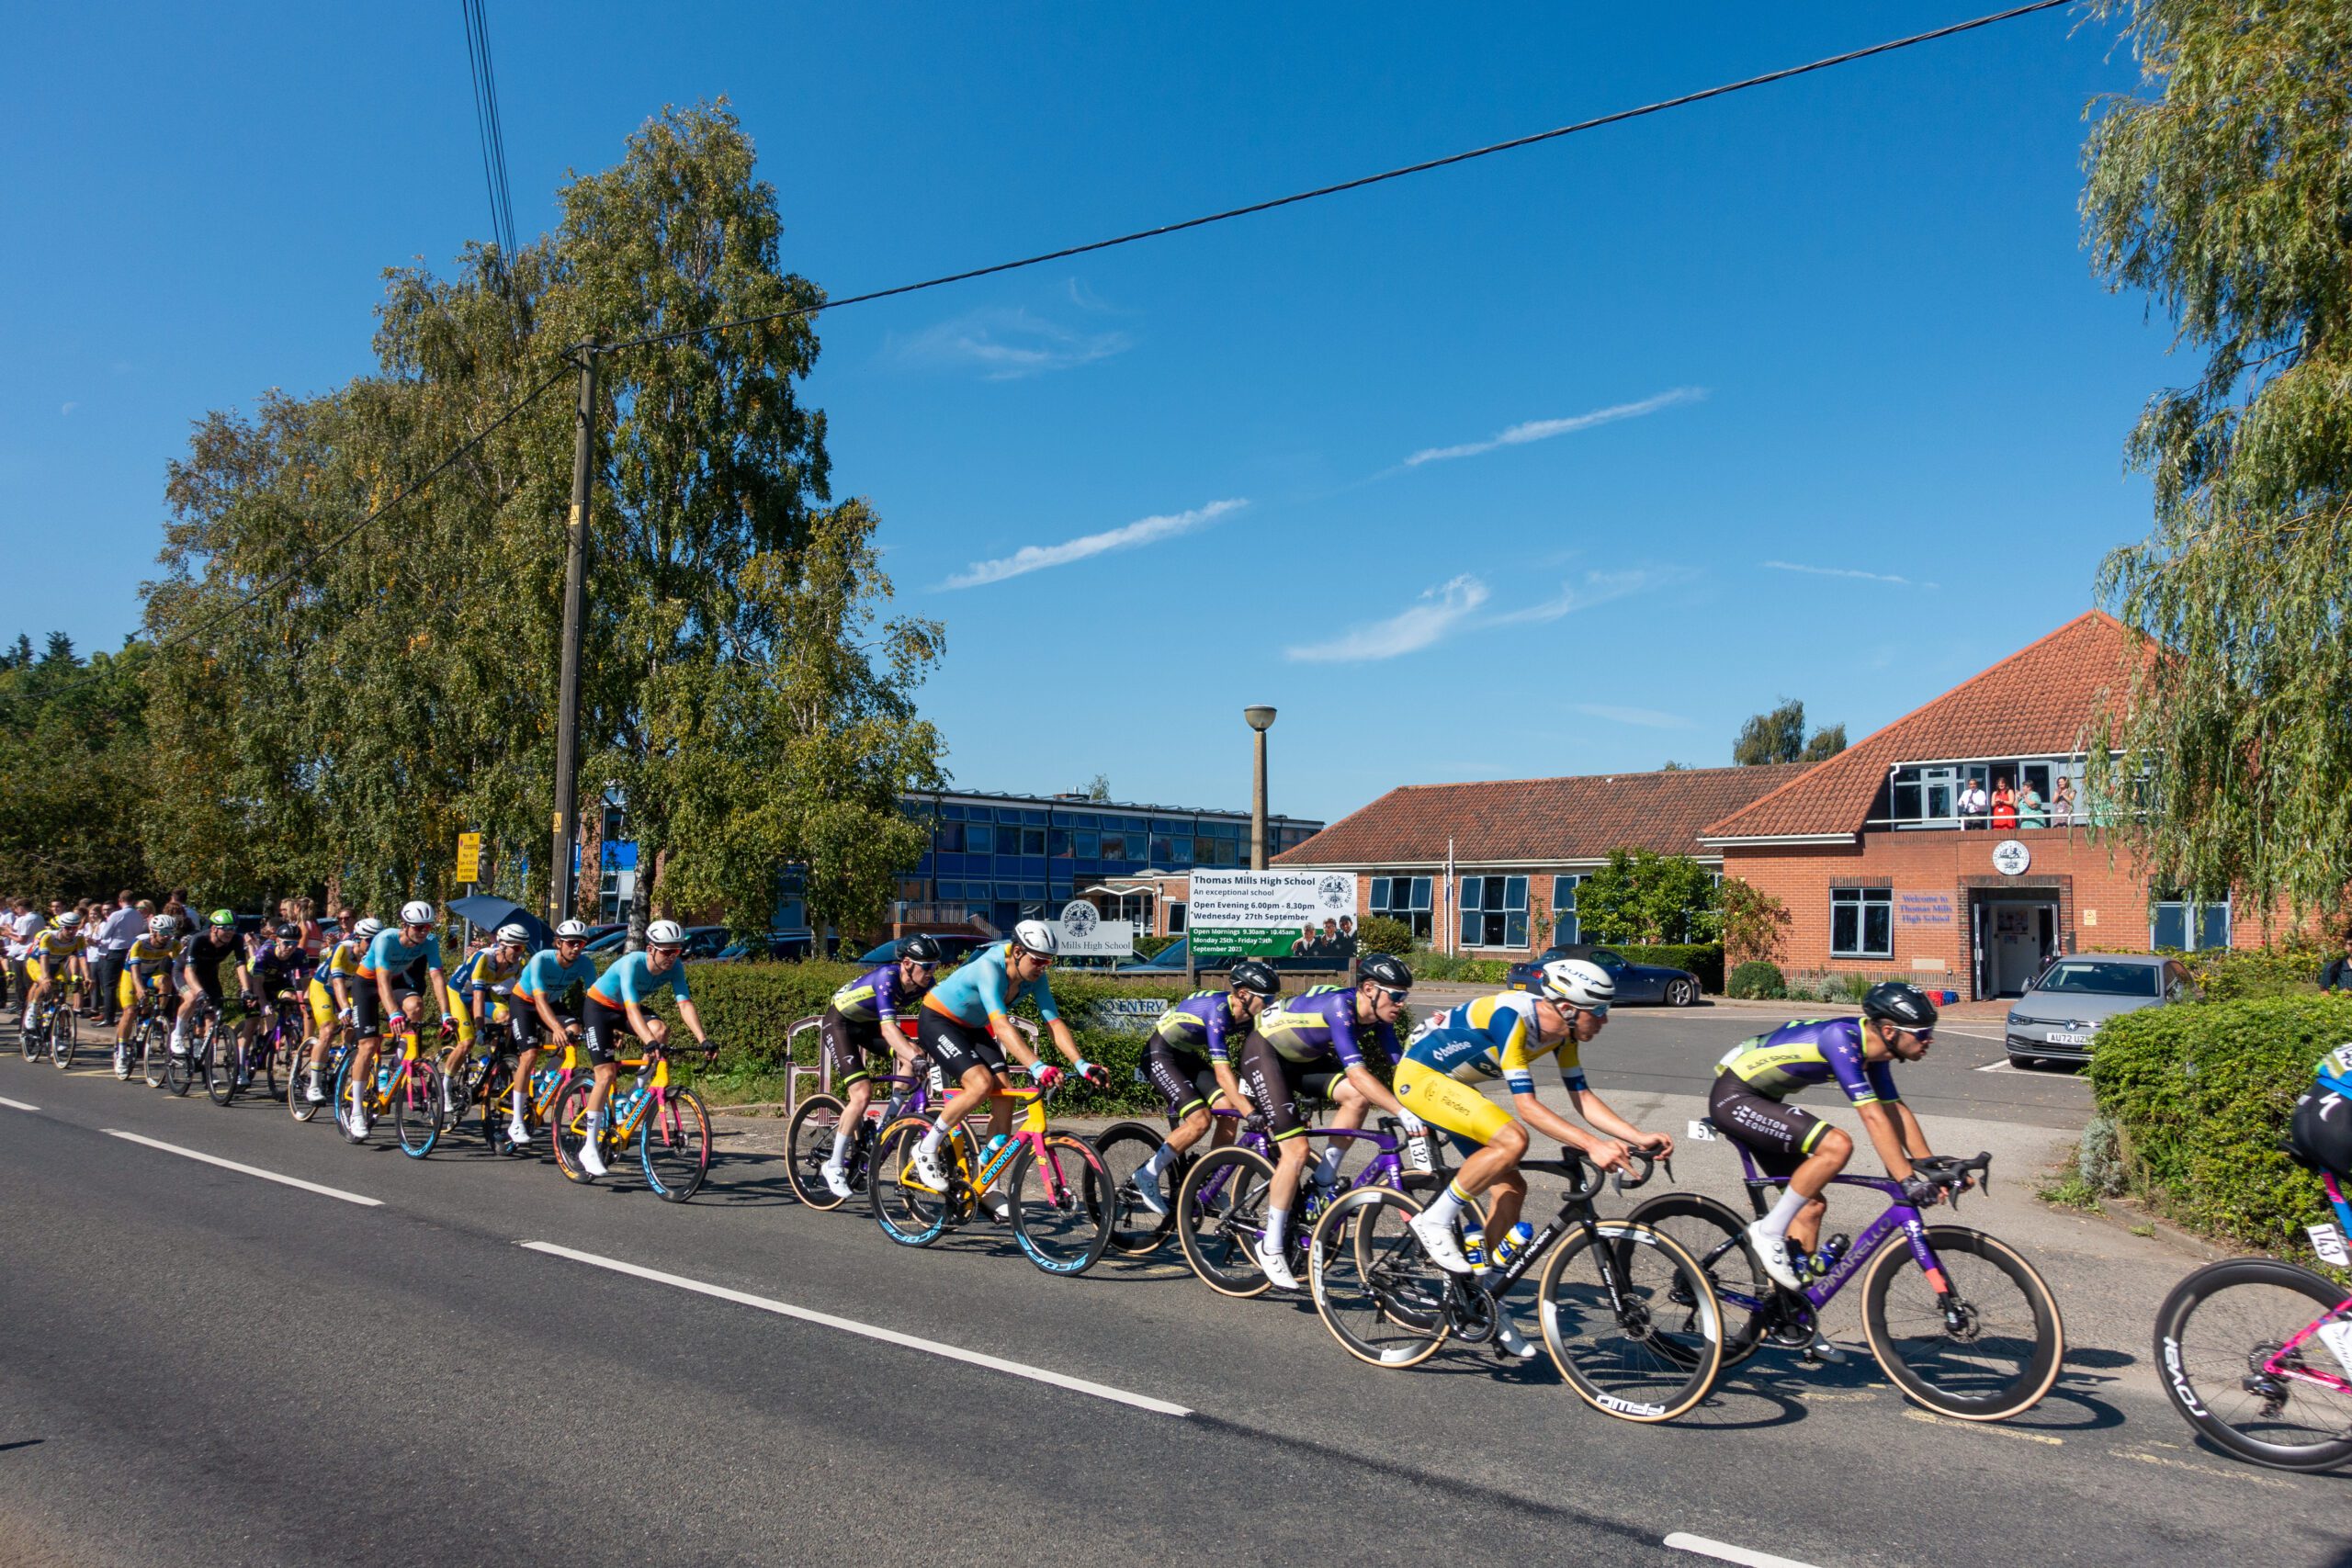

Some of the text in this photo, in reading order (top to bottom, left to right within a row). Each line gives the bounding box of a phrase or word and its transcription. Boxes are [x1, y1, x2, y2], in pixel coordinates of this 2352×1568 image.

[1194, 875, 1316, 886] Thomas Mills High School
[1205, 889, 1249, 897] exceptional
[1903, 895, 1938, 903] Welcome
[1193, 902, 1216, 910] Open
[1216, 902, 1250, 910] Evening
[1250, 902, 1280, 910] 6.00pm
[1286, 903, 1316, 911] 8.30pm
[1193, 913, 1240, 922] Wednesday
[1264, 913, 1309, 922] September
[1902, 915, 1922, 924] High
[1211, 929, 1240, 937] Mornings
[1061, 941, 1131, 951] Mills High School
[1119, 1000, 1163, 1012] ENTRY
[588, 1026, 601, 1053] UNIBET
[937, 1034, 963, 1058] UNIBET
[1439, 1040, 1472, 1058] baloise
[2051, 1034, 2073, 1043] AU72
[931, 1067, 942, 1086] 121
[1159, 1069, 1182, 1093] BOLTON
[1155, 1073, 1180, 1102] EQUITIES
[1259, 1082, 1277, 1118] BOLTON
[1441, 1096, 1470, 1116] Flanders
[625, 1091, 652, 1131] cannondale
[1749, 1111, 1790, 1132] BOLTON
[1744, 1119, 1793, 1141] EQUITIES
[981, 1138, 1021, 1185] cannondale
[1411, 1140, 1428, 1166] 132
[1014, 1231, 1089, 1271] SCOPE
[2312, 1227, 2341, 1257] 143
[1816, 1216, 1892, 1297] PINARELLO
[1596, 1394, 1666, 1416] FFWD
